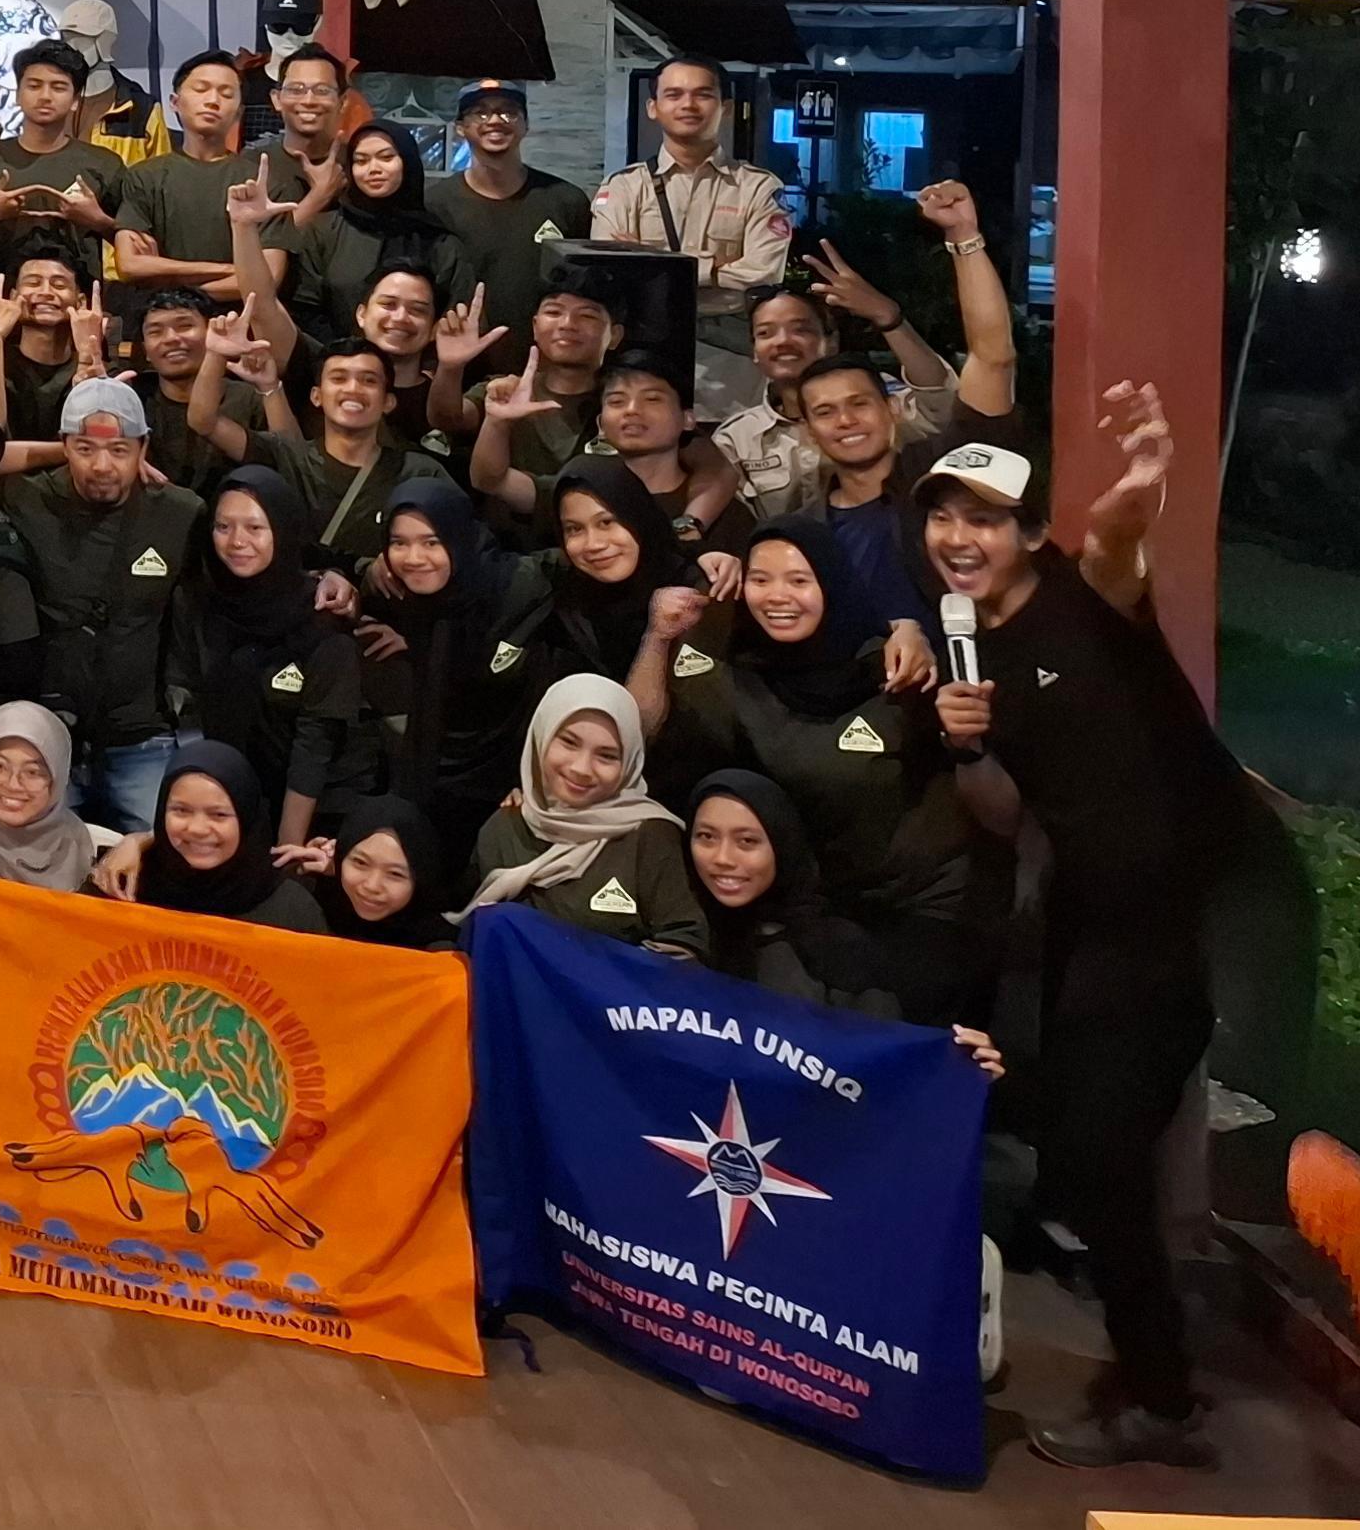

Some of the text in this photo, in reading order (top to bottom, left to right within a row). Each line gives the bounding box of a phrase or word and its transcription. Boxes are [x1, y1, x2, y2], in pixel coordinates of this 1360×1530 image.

[270, 1009, 326, 1114] WONOSOBO
[606, 1006, 863, 1103] MAPALA UNSIQ
[544, 1197, 919, 1375] MAHASISWA PECINTA ALAM
[562, 1250, 871, 1397] UNIVERSITAS SAINS AL-QUR'AN
[618, 1307, 705, 1356] TENGAH
[708, 1344, 731, 1366] DI
[737, 1354, 861, 1420] WONOSOBO
